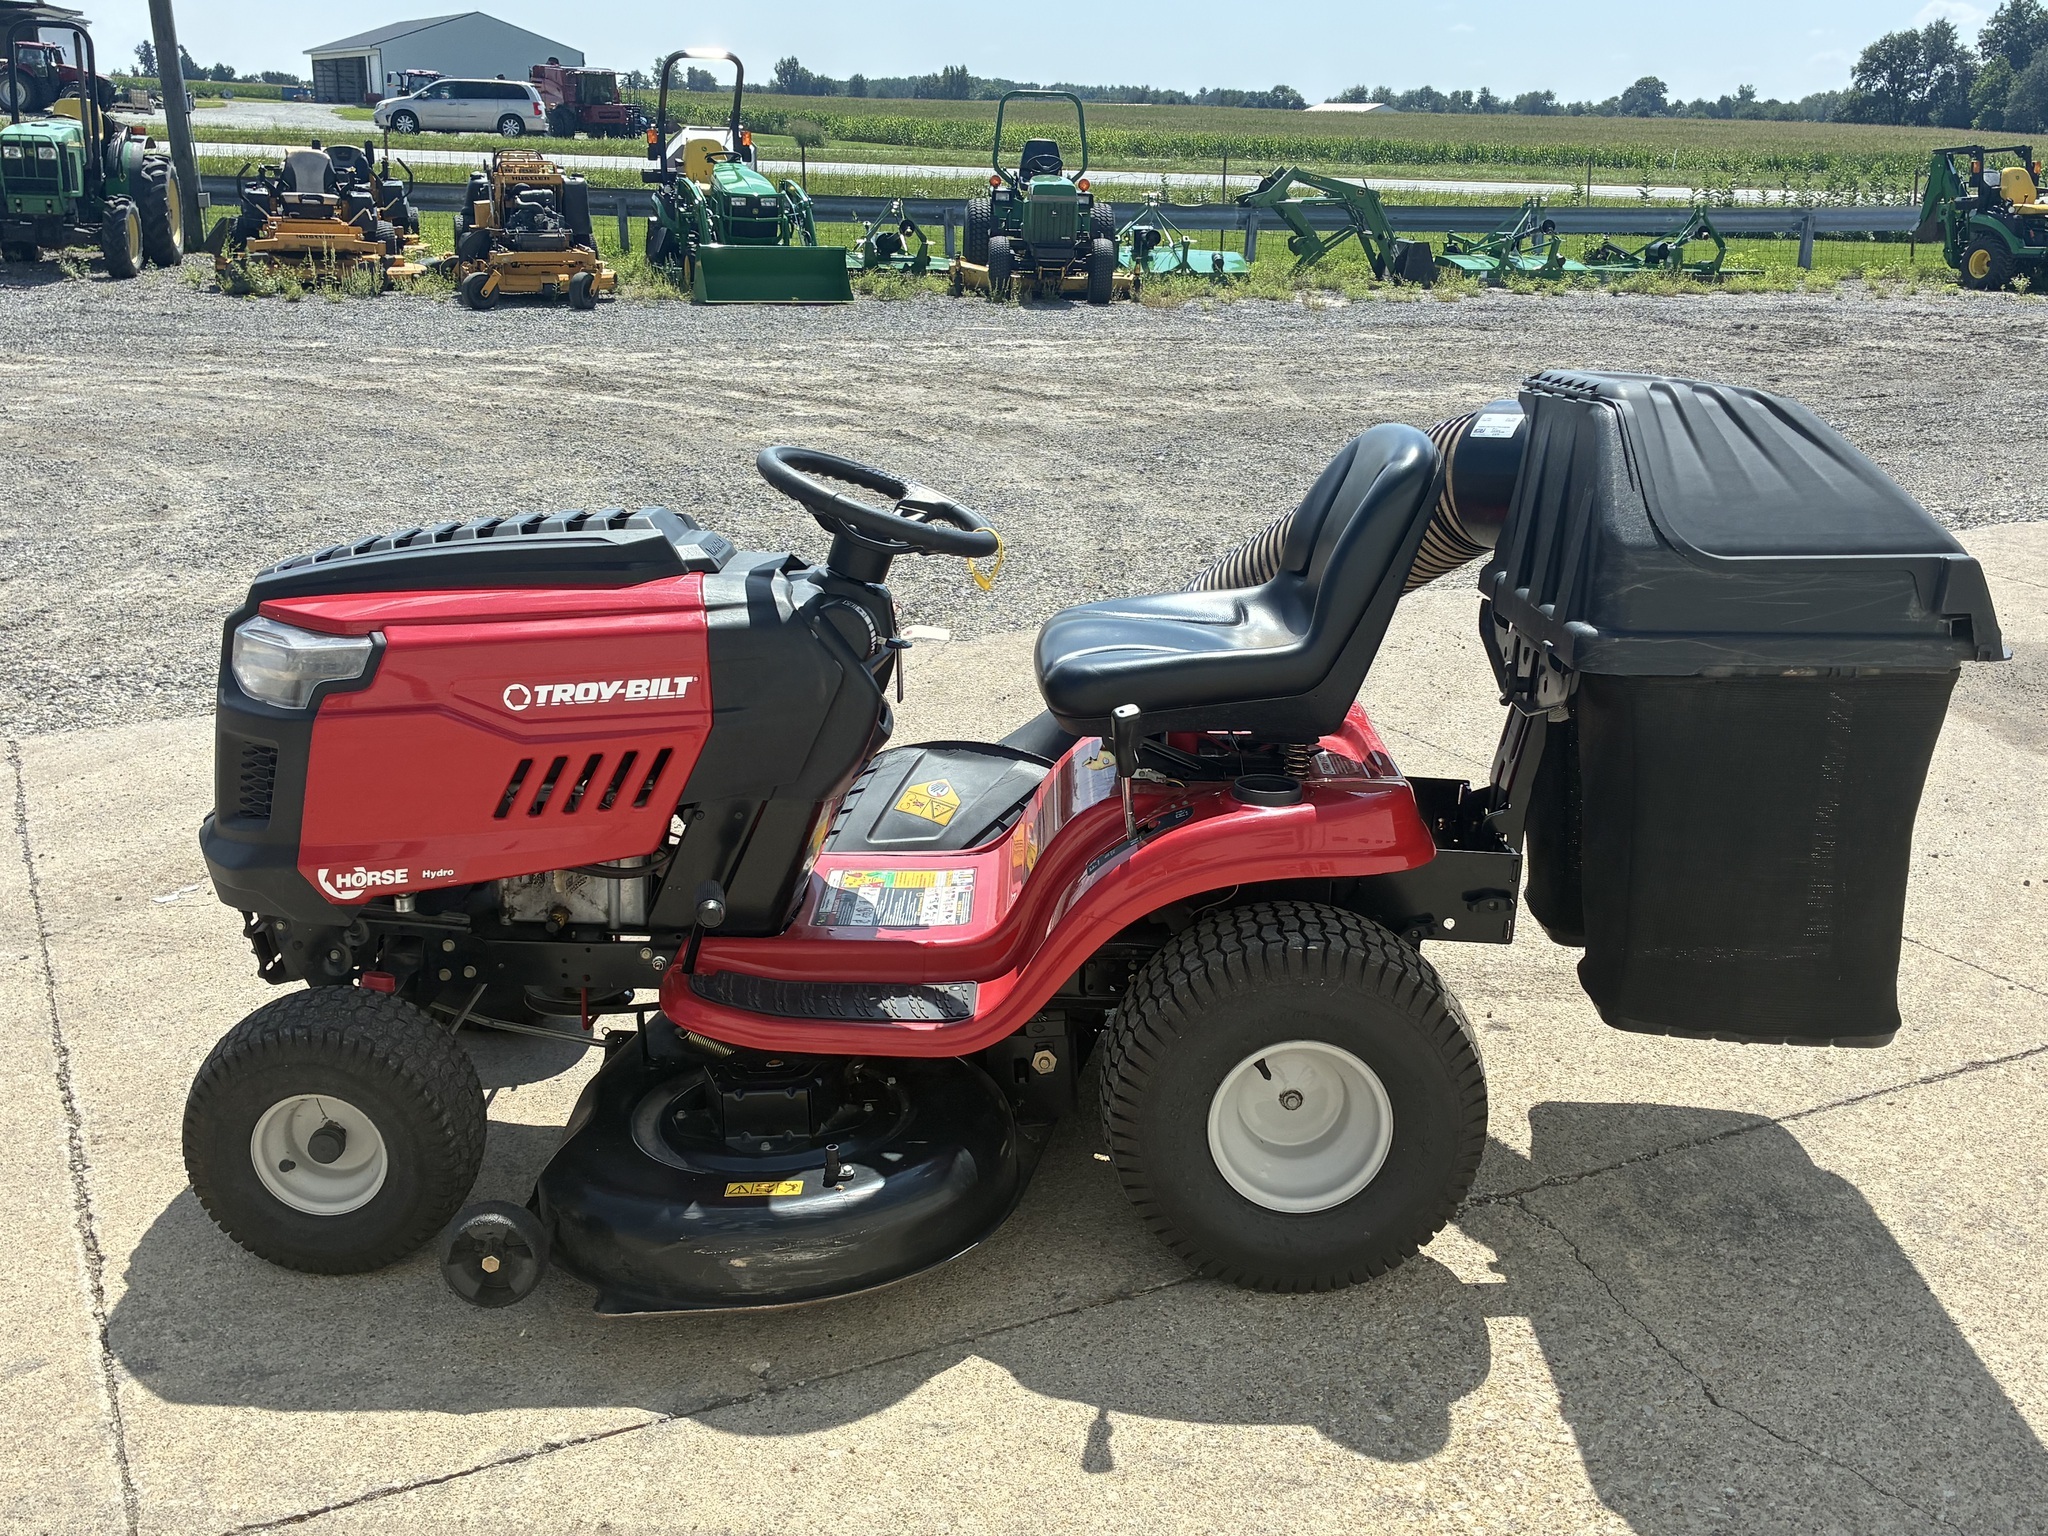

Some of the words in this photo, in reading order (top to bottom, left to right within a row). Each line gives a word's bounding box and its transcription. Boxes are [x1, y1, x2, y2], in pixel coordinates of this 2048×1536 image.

[533, 676, 694, 707] TROY-BILT
[336, 868, 409, 888] HORSE
[422, 869, 454, 879] Hydro
